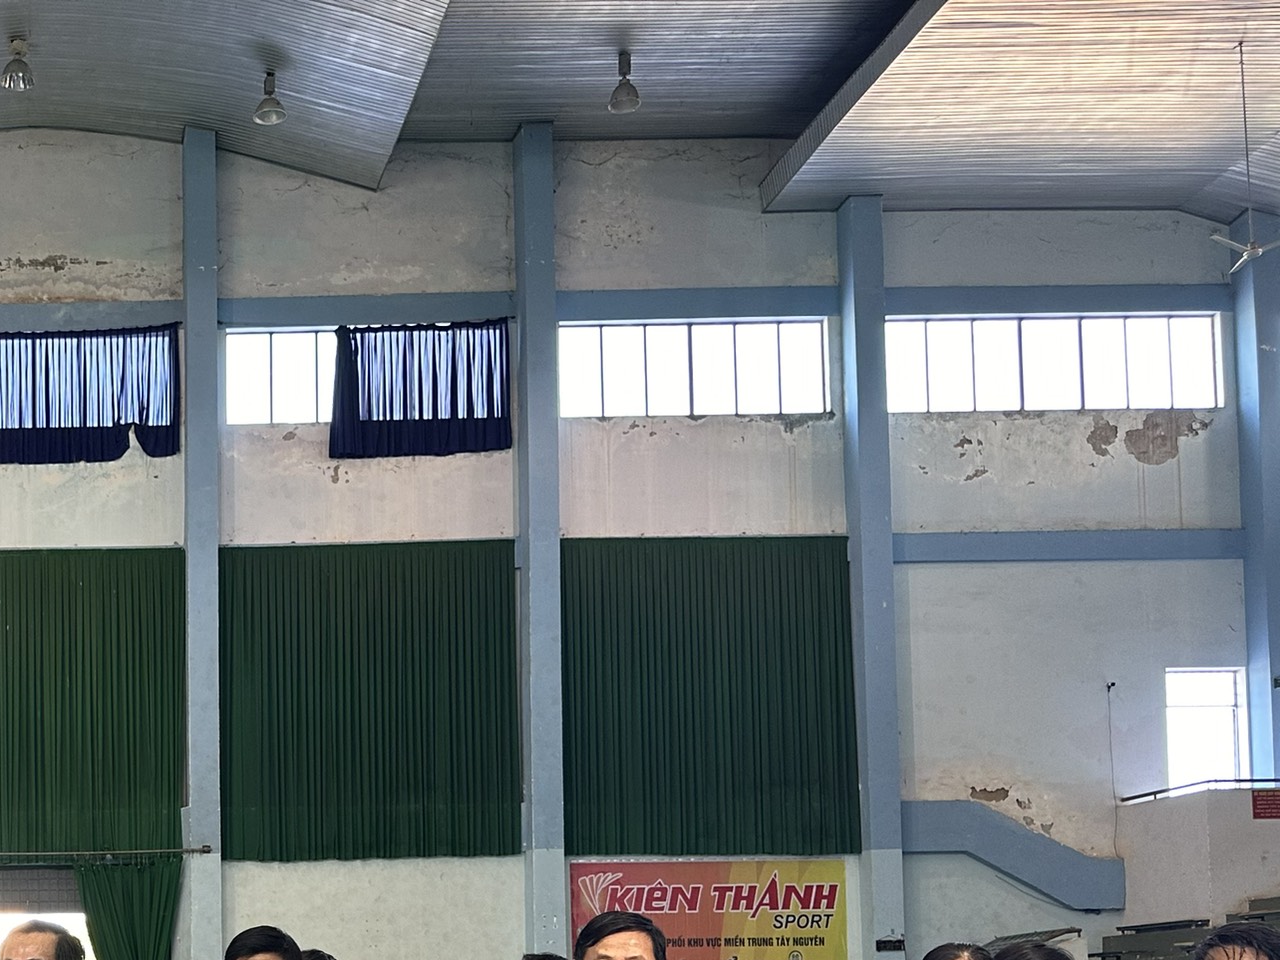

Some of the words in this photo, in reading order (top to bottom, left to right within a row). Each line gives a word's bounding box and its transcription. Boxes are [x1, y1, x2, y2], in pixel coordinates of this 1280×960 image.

[773, 914, 834, 929] SPORT
[688, 938, 703, 946] KHU
[748, 938, 773, 946] TRUNG
